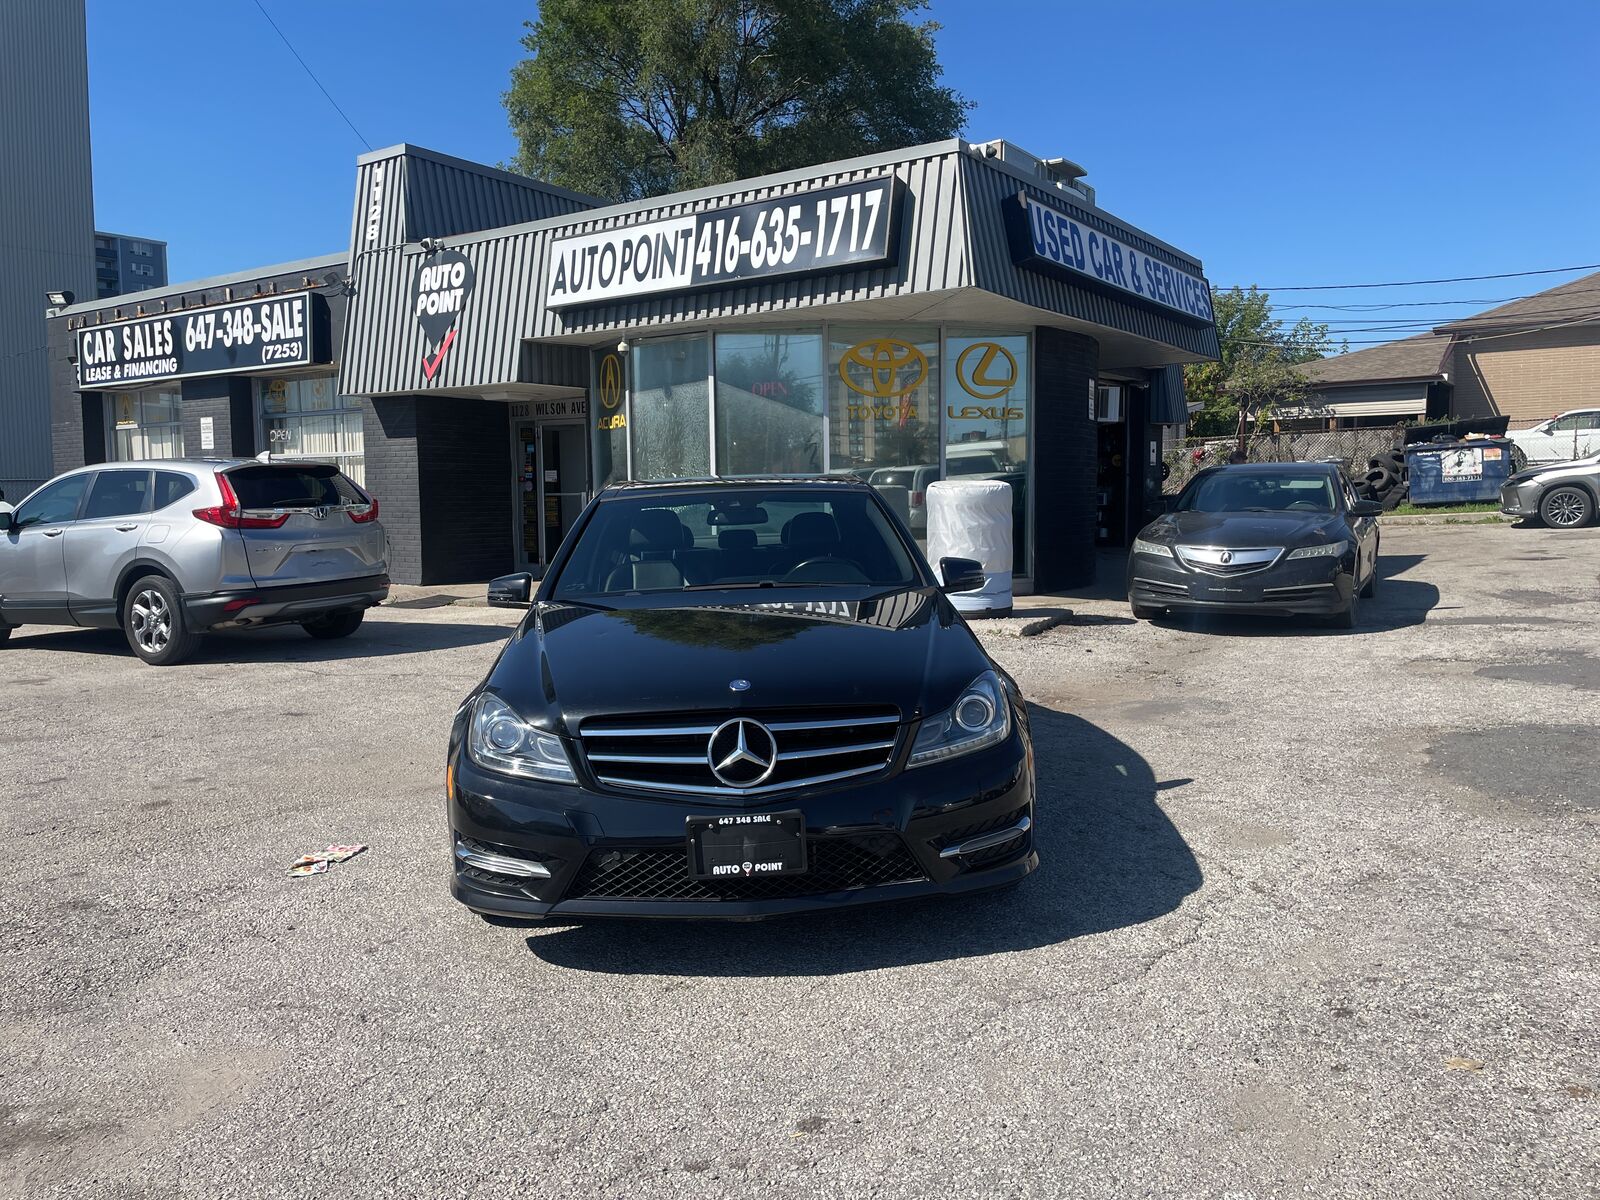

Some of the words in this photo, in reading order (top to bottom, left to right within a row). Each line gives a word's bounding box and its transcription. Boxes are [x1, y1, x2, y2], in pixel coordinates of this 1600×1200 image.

[366, 167, 383, 241] 1128
[696, 188, 884, 277] 416-635-1717
[1027, 202, 1086, 271] USED
[1088, 231, 1129, 289] CAR
[1129, 250, 1144, 295] &
[1144, 257, 1213, 320] SERVICES
[419, 261, 466, 293] AUTO
[416, 288, 464, 317] POINT
[185, 299, 304, 352] 647-348-SALE
[83, 330, 117, 365] CAR
[122, 319, 173, 360] SALES
[261, 340, 303, 364] (7253)
[85, 365, 112, 382] LEASE
[113, 364, 122, 379] &
[123, 357, 178, 378] FINANCING
[752, 382, 788, 396] OPEN
[536, 404, 566, 415] WILSON
[571, 402, 586, 414] AVE
[847, 405, 918, 420] TOYOTA
[947, 405, 1024, 420] LEXUS
[598, 414, 627, 430] ACURA
[269, 429, 292, 443] OPEN
[718, 817, 734, 825] 647
[735, 816, 751, 824] 348
[752, 814, 771, 823] SALE
[712, 864, 740, 875] AUTO
[754, 862, 782, 872] POINT
